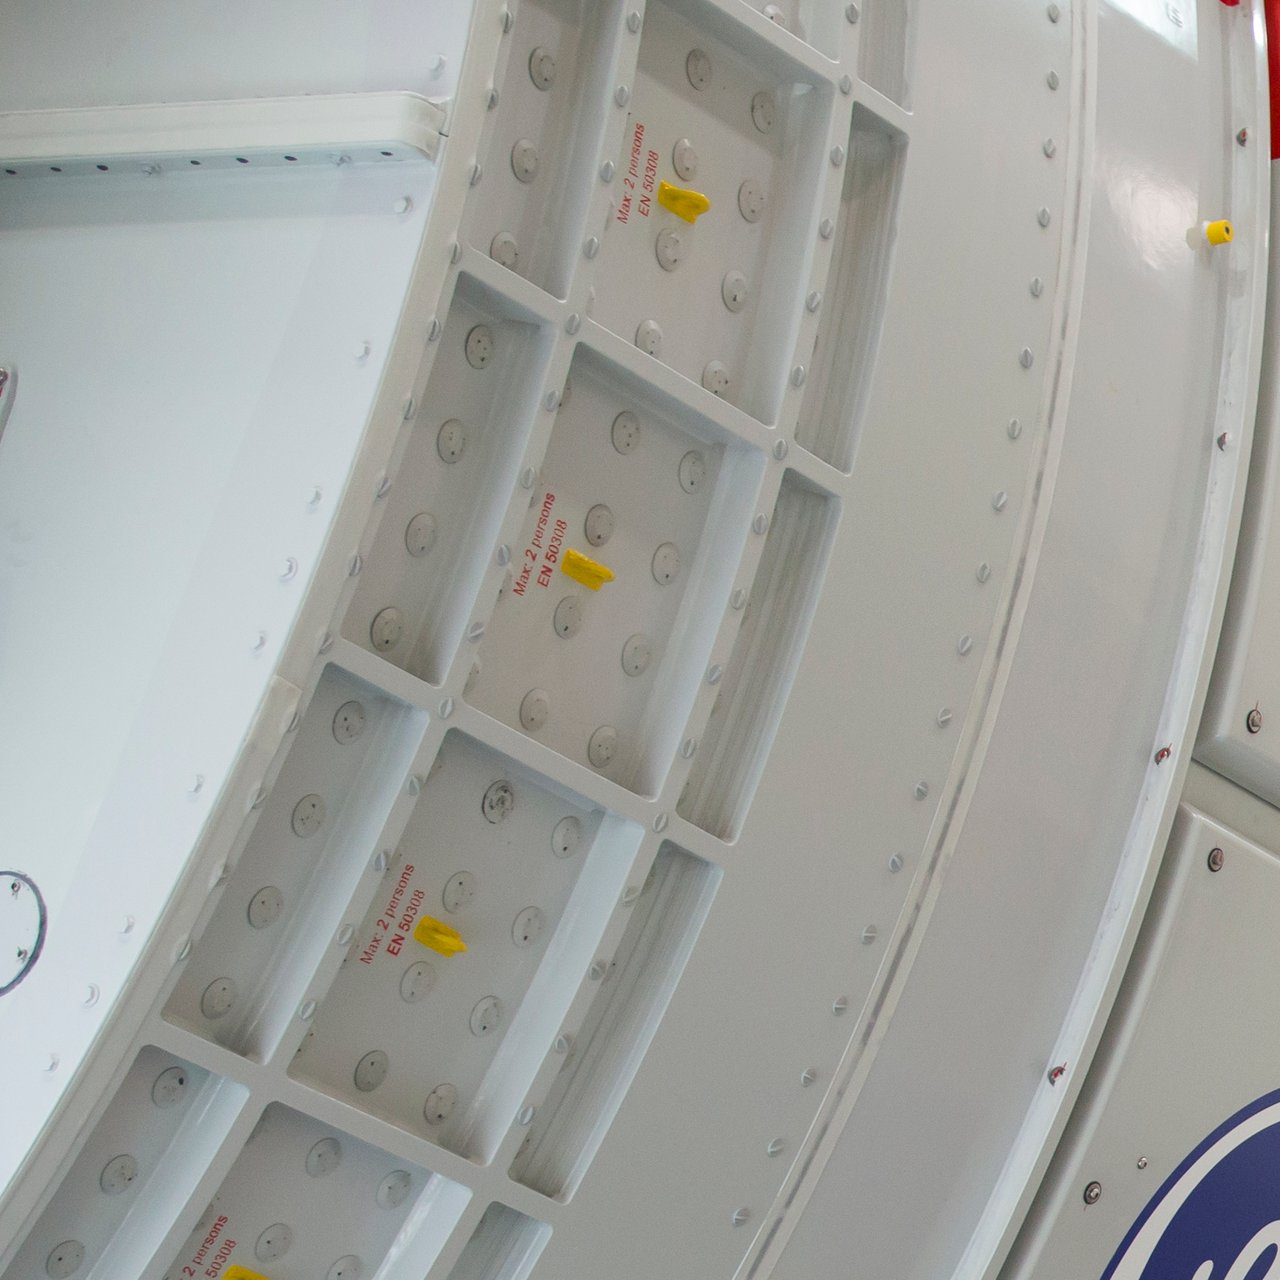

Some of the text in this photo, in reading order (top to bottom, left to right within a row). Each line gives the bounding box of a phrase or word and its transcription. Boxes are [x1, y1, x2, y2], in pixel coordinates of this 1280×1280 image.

[624, 178, 635, 190] 2
[629, 123, 645, 178] persons
[638, 150, 659, 217] EN 50308
[525, 549, 537, 561] 2
[532, 493, 555, 549] persons
[537, 519, 567, 587] EN 50308
[376, 919, 389, 931] 2
[385, 864, 415, 919] persons
[386, 889, 425, 957] EN 50308
[182, 1266, 196, 1277] 2
[192, 1215, 228, 1266] persons
[205, 1239, 237, 1278] 50308
